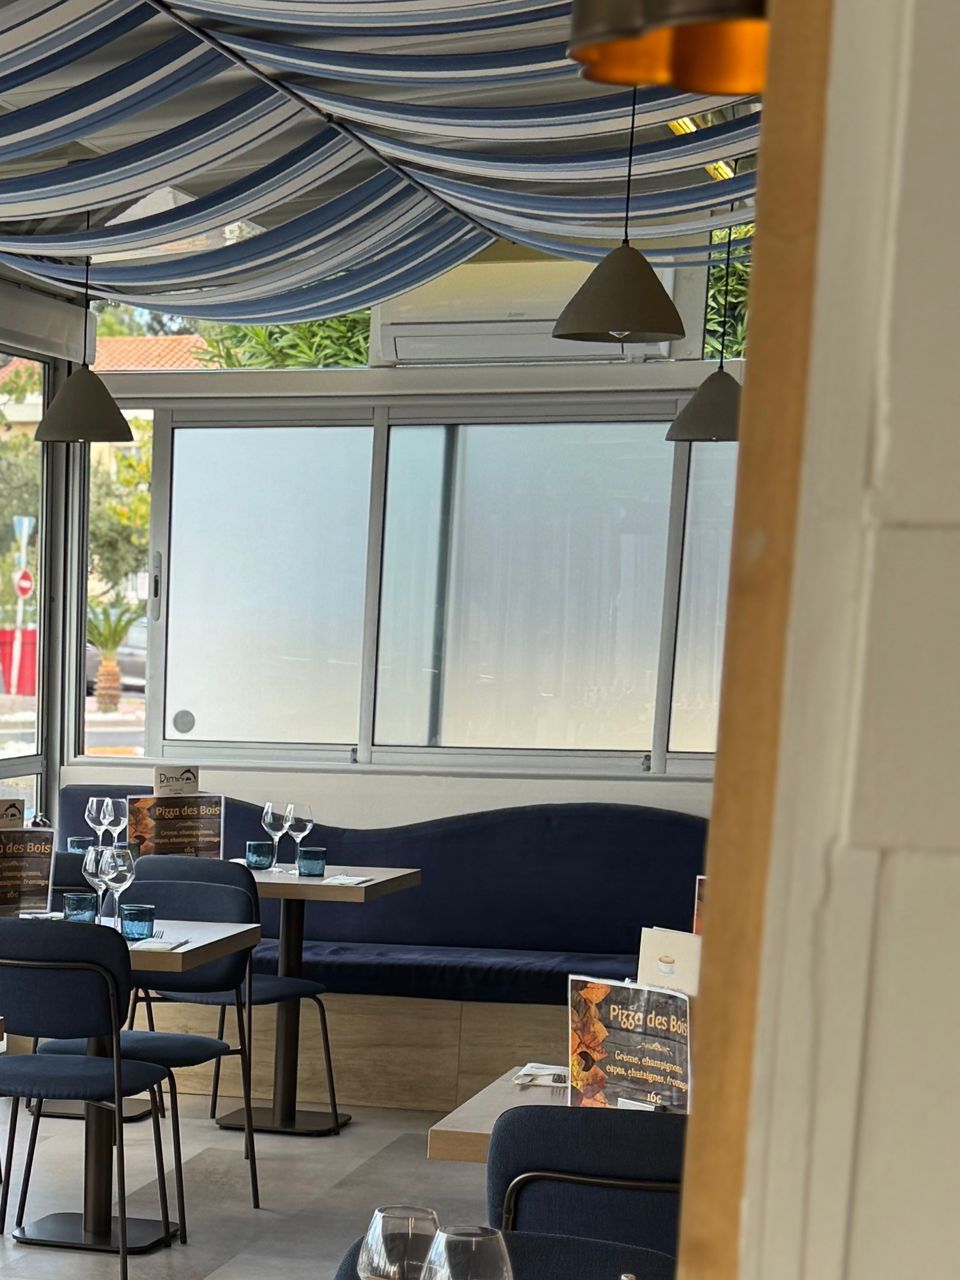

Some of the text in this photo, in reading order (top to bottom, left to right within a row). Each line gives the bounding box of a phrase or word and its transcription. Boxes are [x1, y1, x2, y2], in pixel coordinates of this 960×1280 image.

[155, 805, 220, 819] Pizza des Bois
[6, 842, 25, 853] des
[26, 841, 51, 854] Bois
[609, 1004, 688, 1037] Pizza des Bois
